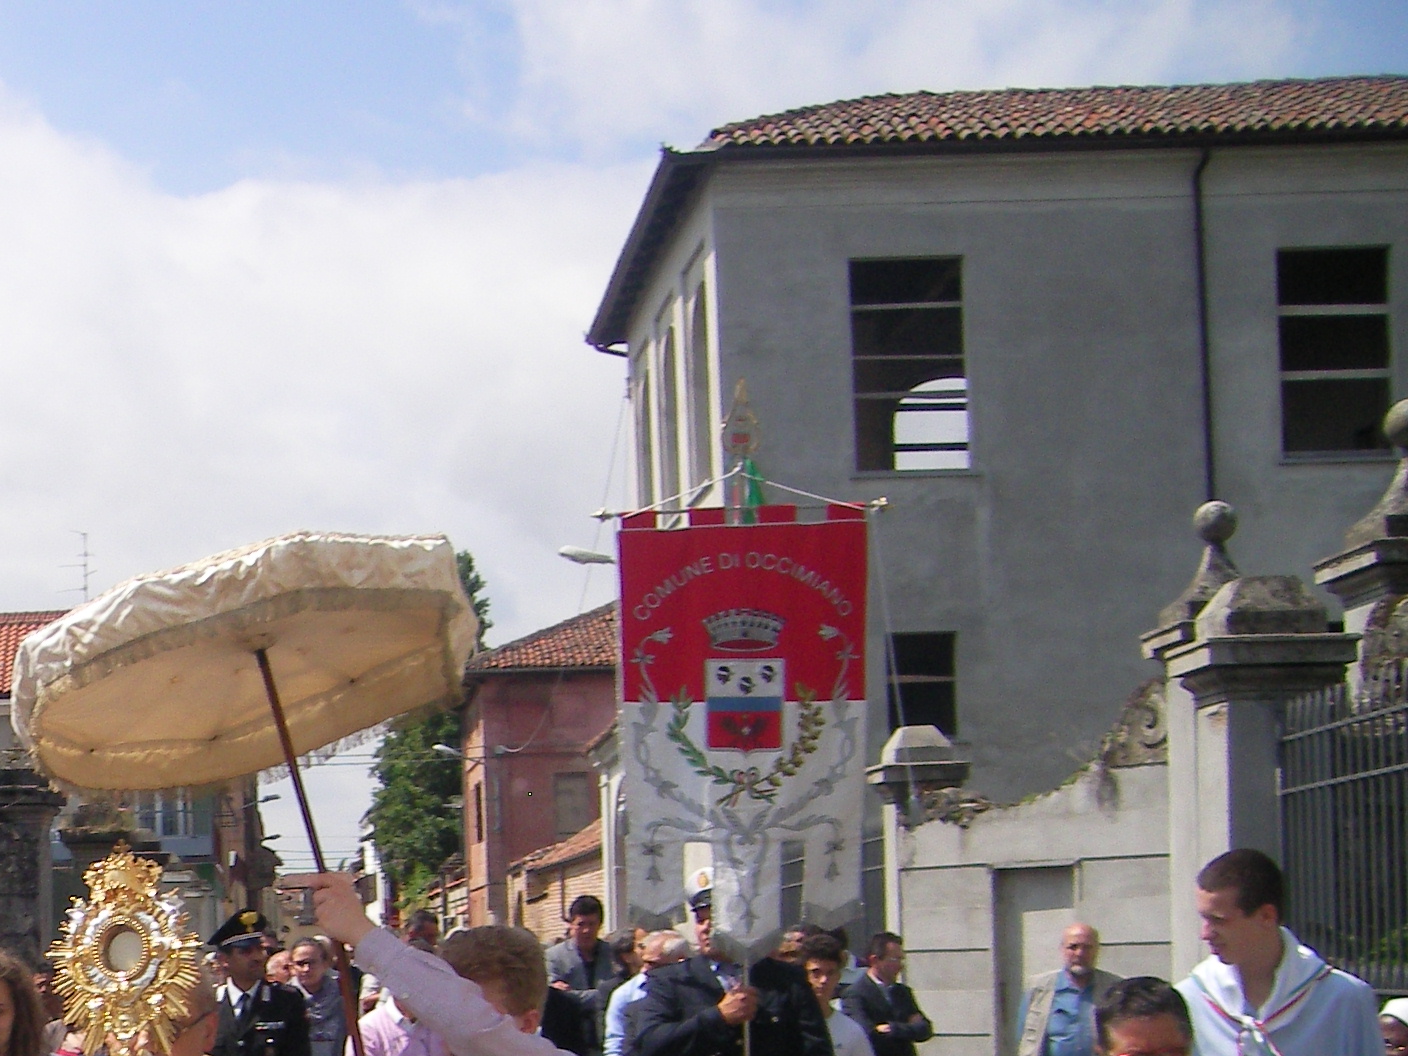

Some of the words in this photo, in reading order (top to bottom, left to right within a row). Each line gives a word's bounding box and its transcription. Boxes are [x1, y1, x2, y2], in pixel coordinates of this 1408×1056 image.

[633, 556, 714, 620] COMUNE
[719, 553, 740, 570] DI
[746, 552, 853, 616] OCCIMIANO
